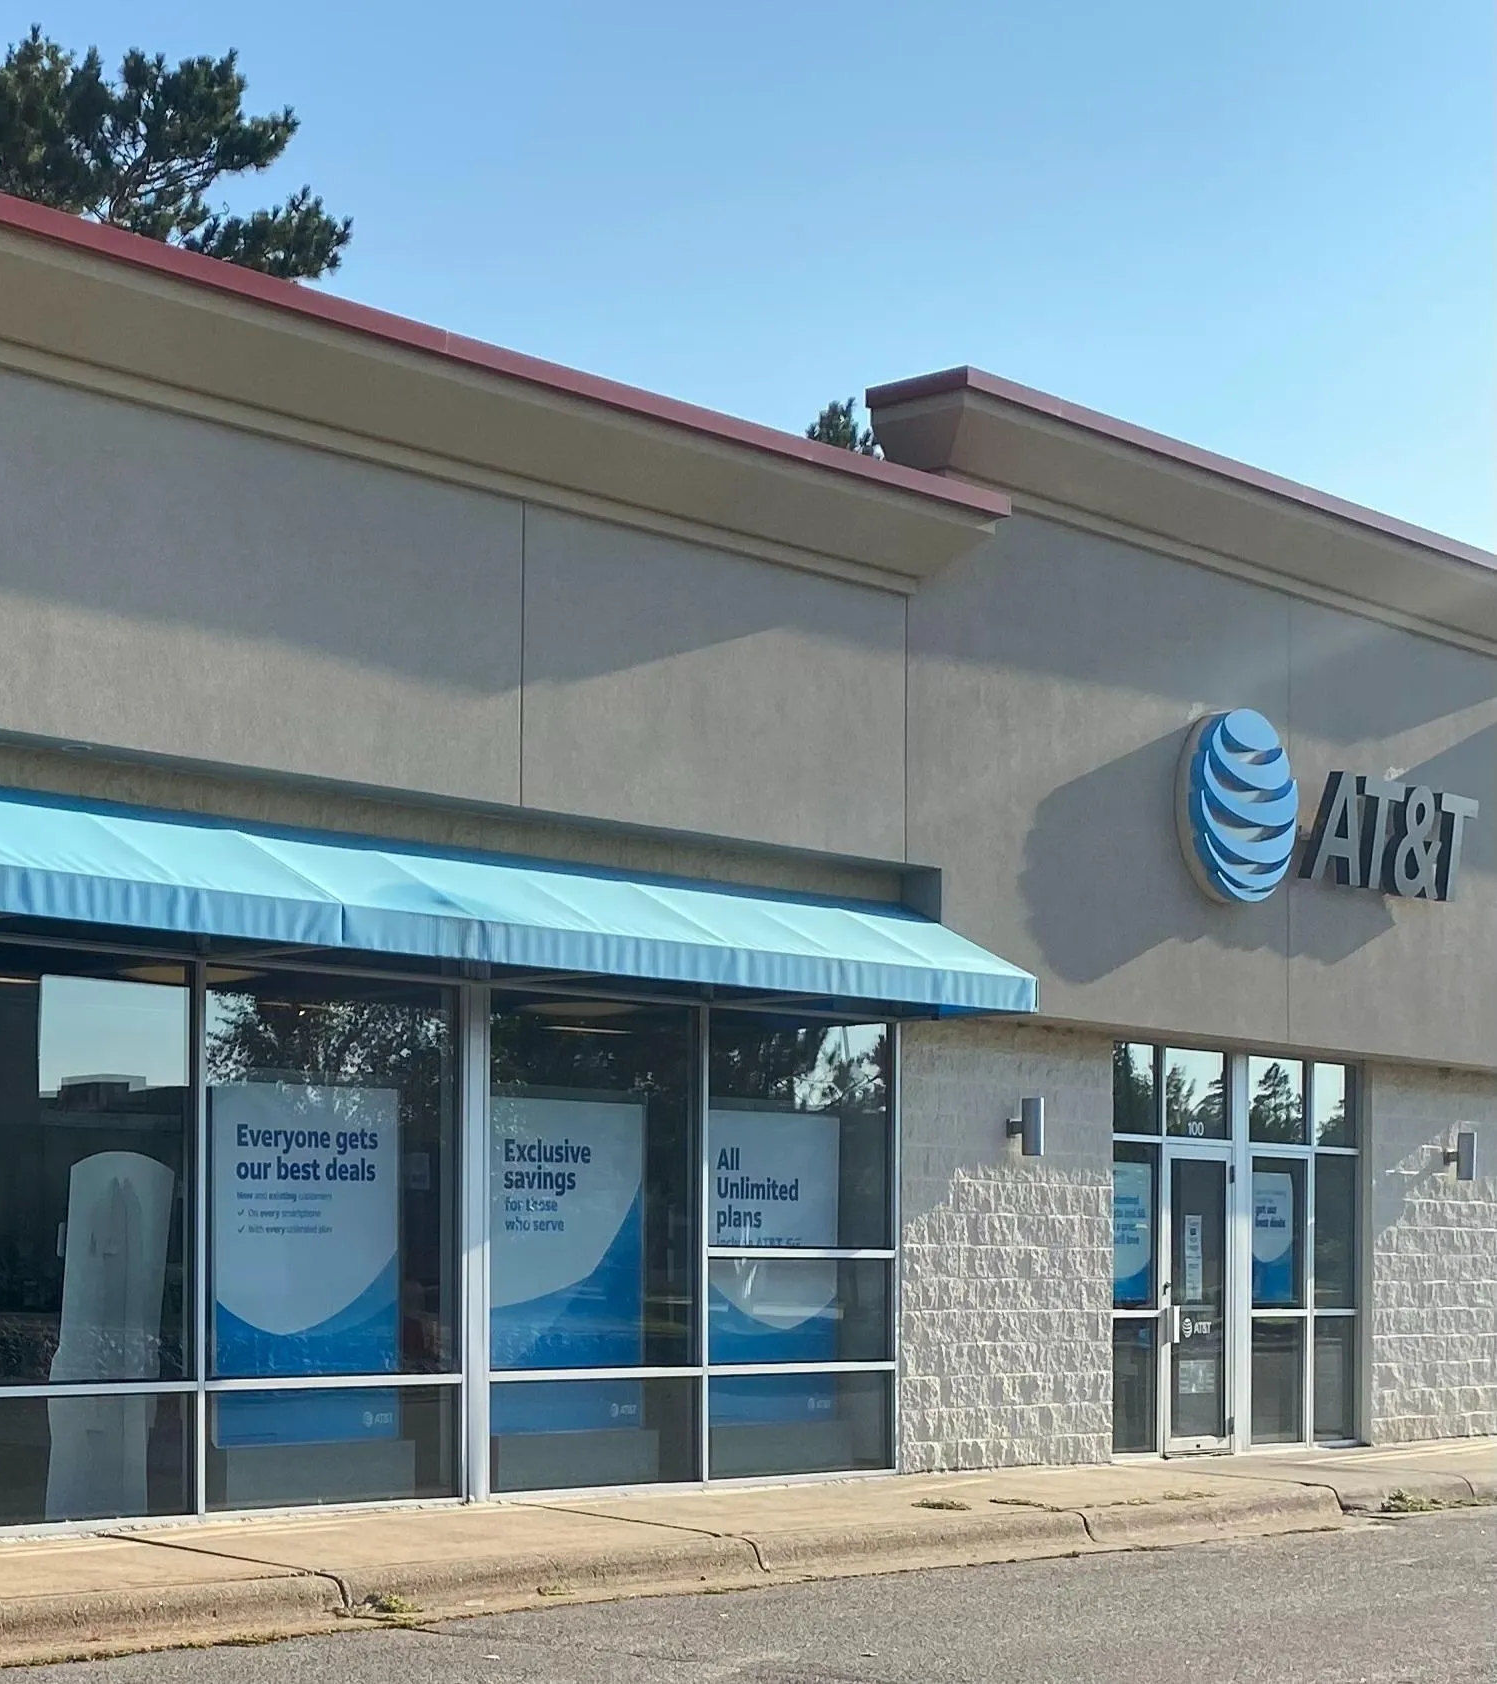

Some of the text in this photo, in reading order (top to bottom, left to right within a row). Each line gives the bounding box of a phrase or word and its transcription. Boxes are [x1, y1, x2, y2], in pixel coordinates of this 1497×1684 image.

[1298, 770, 1479, 901] AT&T
[236, 1123, 378, 1155] Everyone gets
[1187, 1121, 1204, 1136] 100
[504, 1138, 591, 1164] Exclusive
[716, 1147, 740, 1171] All
[236, 1156, 376, 1182] our best deals
[504, 1165, 576, 1196] savings
[717, 1176, 799, 1201] Unlimited
[505, 1197, 523, 1212] for
[505, 1216, 564, 1231] who serve
[716, 1204, 762, 1234] plans
